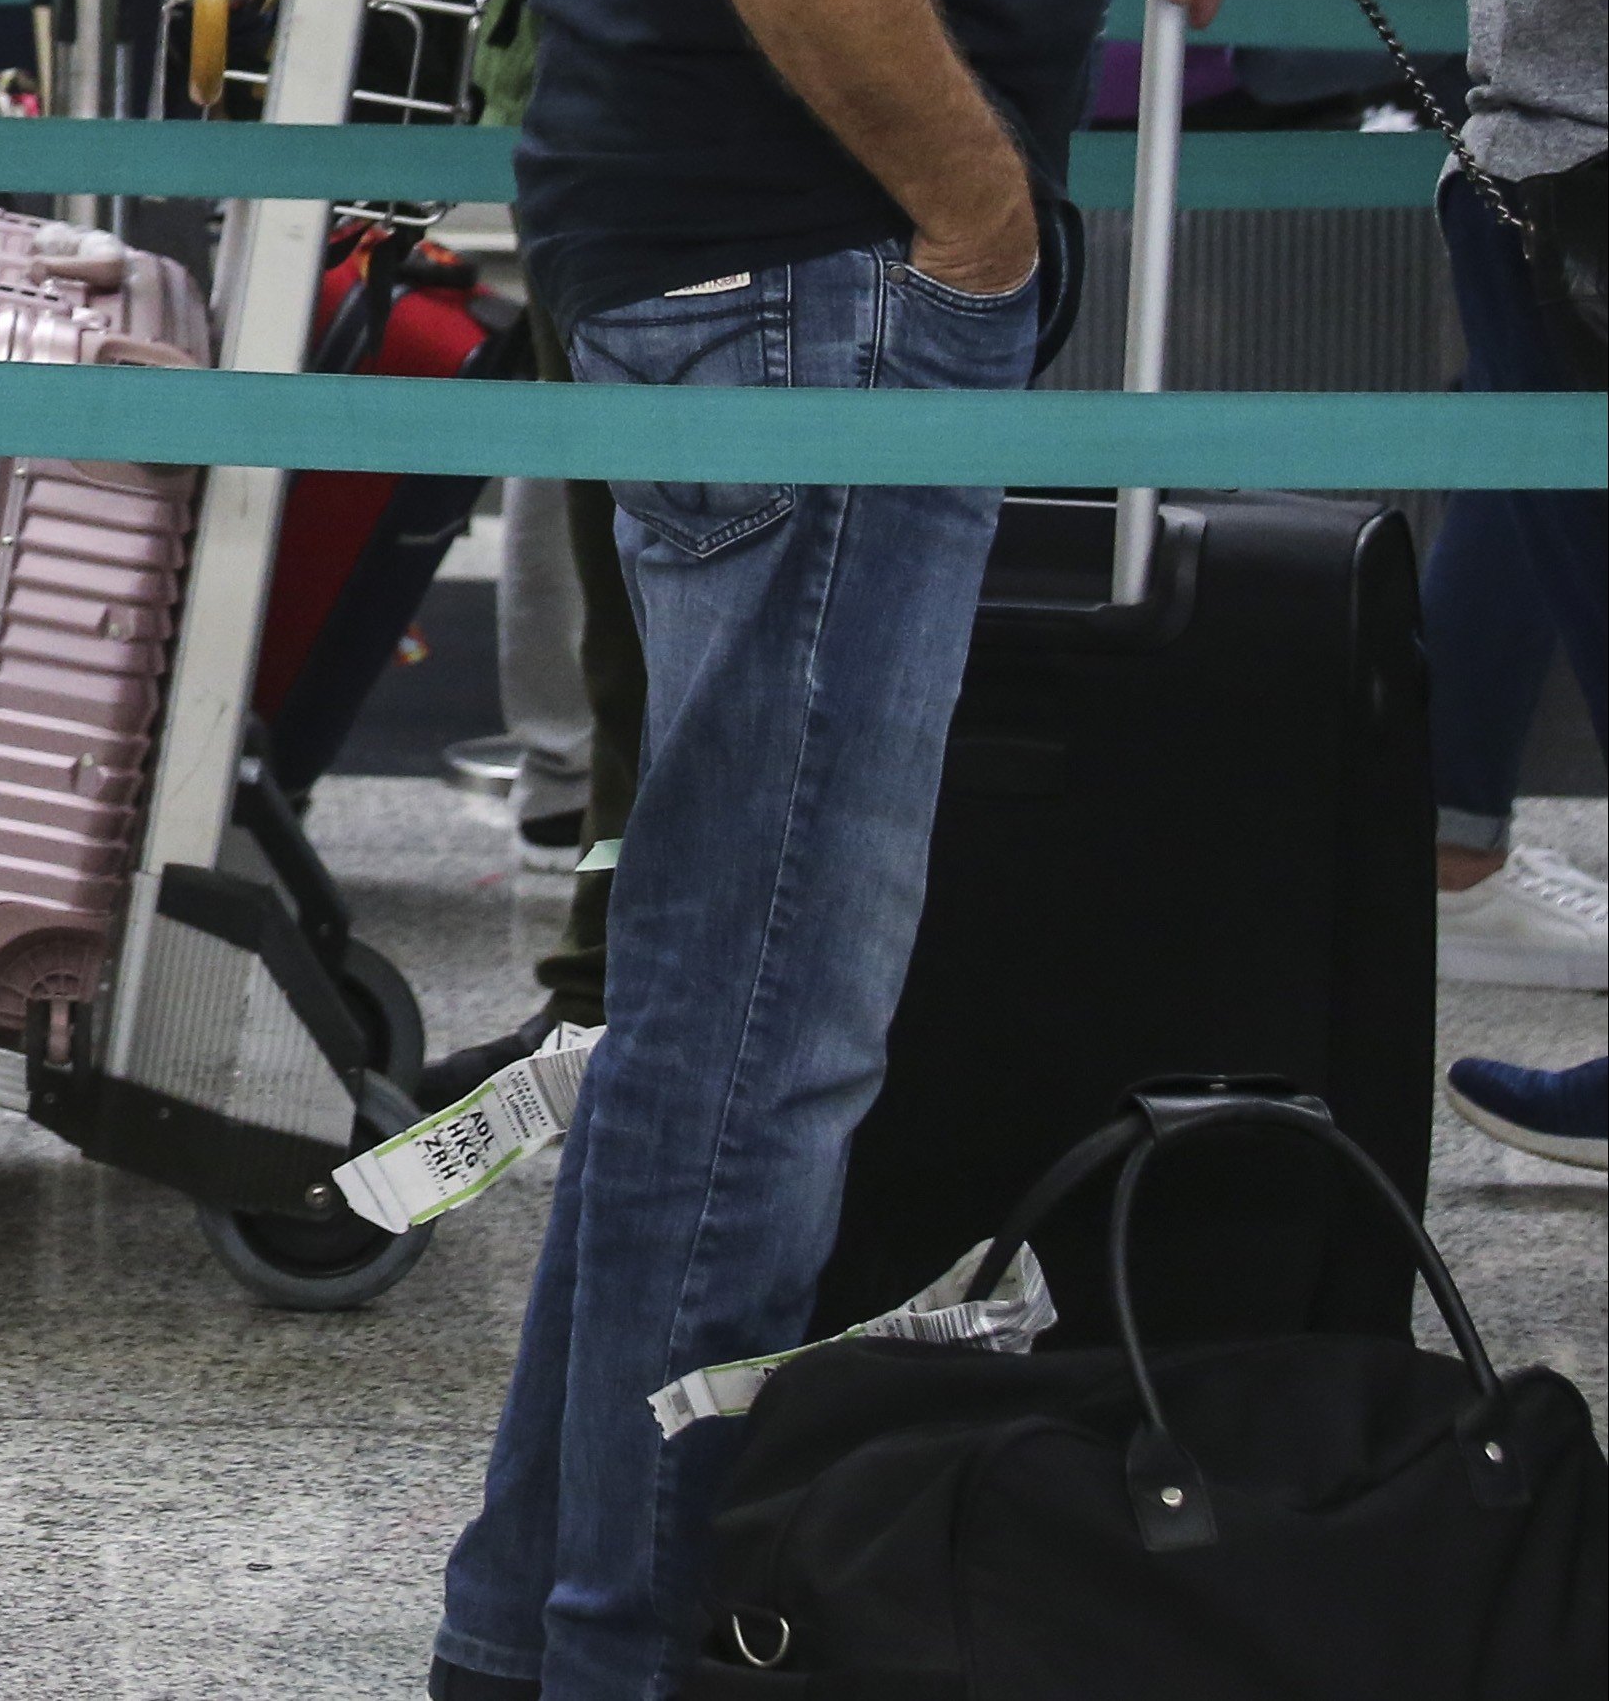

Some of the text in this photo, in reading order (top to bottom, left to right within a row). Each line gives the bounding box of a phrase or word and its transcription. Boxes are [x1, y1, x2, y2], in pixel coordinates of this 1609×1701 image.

[447, 1122, 478, 1168] HKG
[470, 1111, 494, 1152] ADL
[423, 1139, 458, 1180] ZRH
